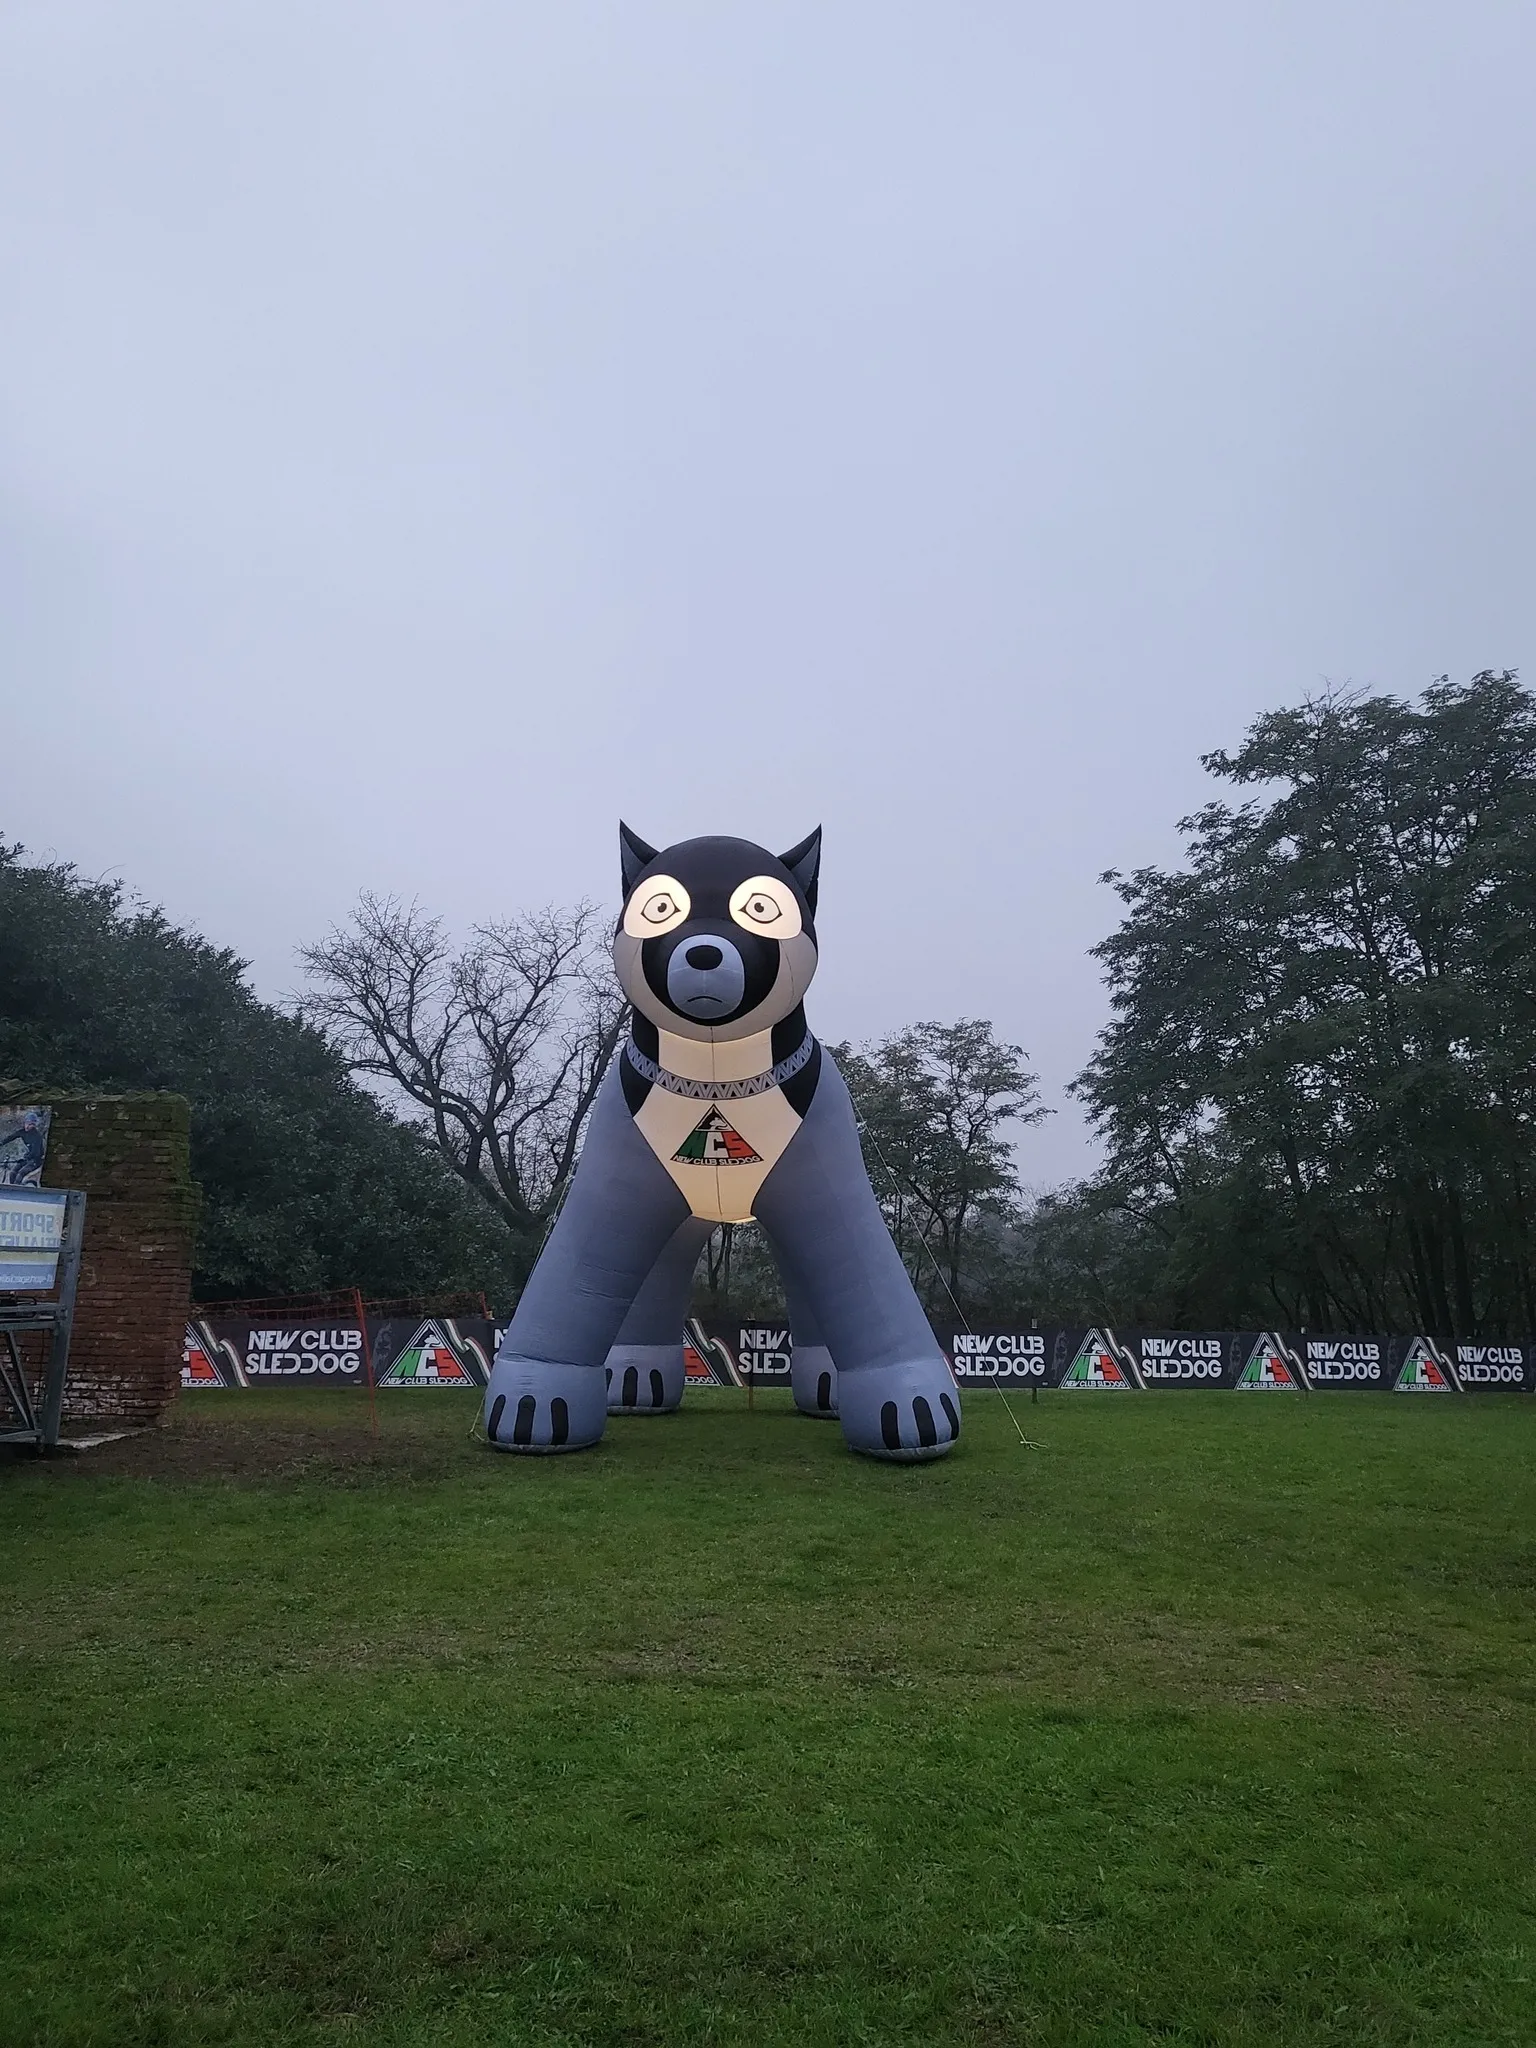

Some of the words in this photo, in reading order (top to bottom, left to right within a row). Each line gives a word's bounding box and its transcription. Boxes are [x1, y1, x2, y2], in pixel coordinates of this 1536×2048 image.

[673, 1155, 693, 1164] NEW
[719, 1155, 760, 1165] SLEDDOG
[248, 1330, 300, 1350] NEW
[300, 1330, 362, 1350] CLUB
[740, 1329, 788, 1349] NEW
[953, 1335, 995, 1353] NEW
[996, 1335, 1045, 1354] CLUB
[1141, 1339, 1178, 1356] NEW
[1178, 1339, 1221, 1357] CLUB
[1306, 1342, 1340, 1359] NEW
[1340, 1343, 1380, 1360] CLUB
[1456, 1346, 1487, 1362] NEW
[1487, 1347, 1523, 1364] CLUB
[245, 1352, 360, 1374] SLEDDOG
[738, 1352, 792, 1374] SLED
[954, 1356, 1045, 1376] SLEDDOG
[1142, 1359, 1222, 1378] SLEDDOG
[1307, 1361, 1381, 1380] SLEDDOG
[384, 1377, 405, 1385] NEW
[429, 1377, 468, 1385] SLEDDOG
[1458, 1364, 1524, 1382] SLEDDOG
